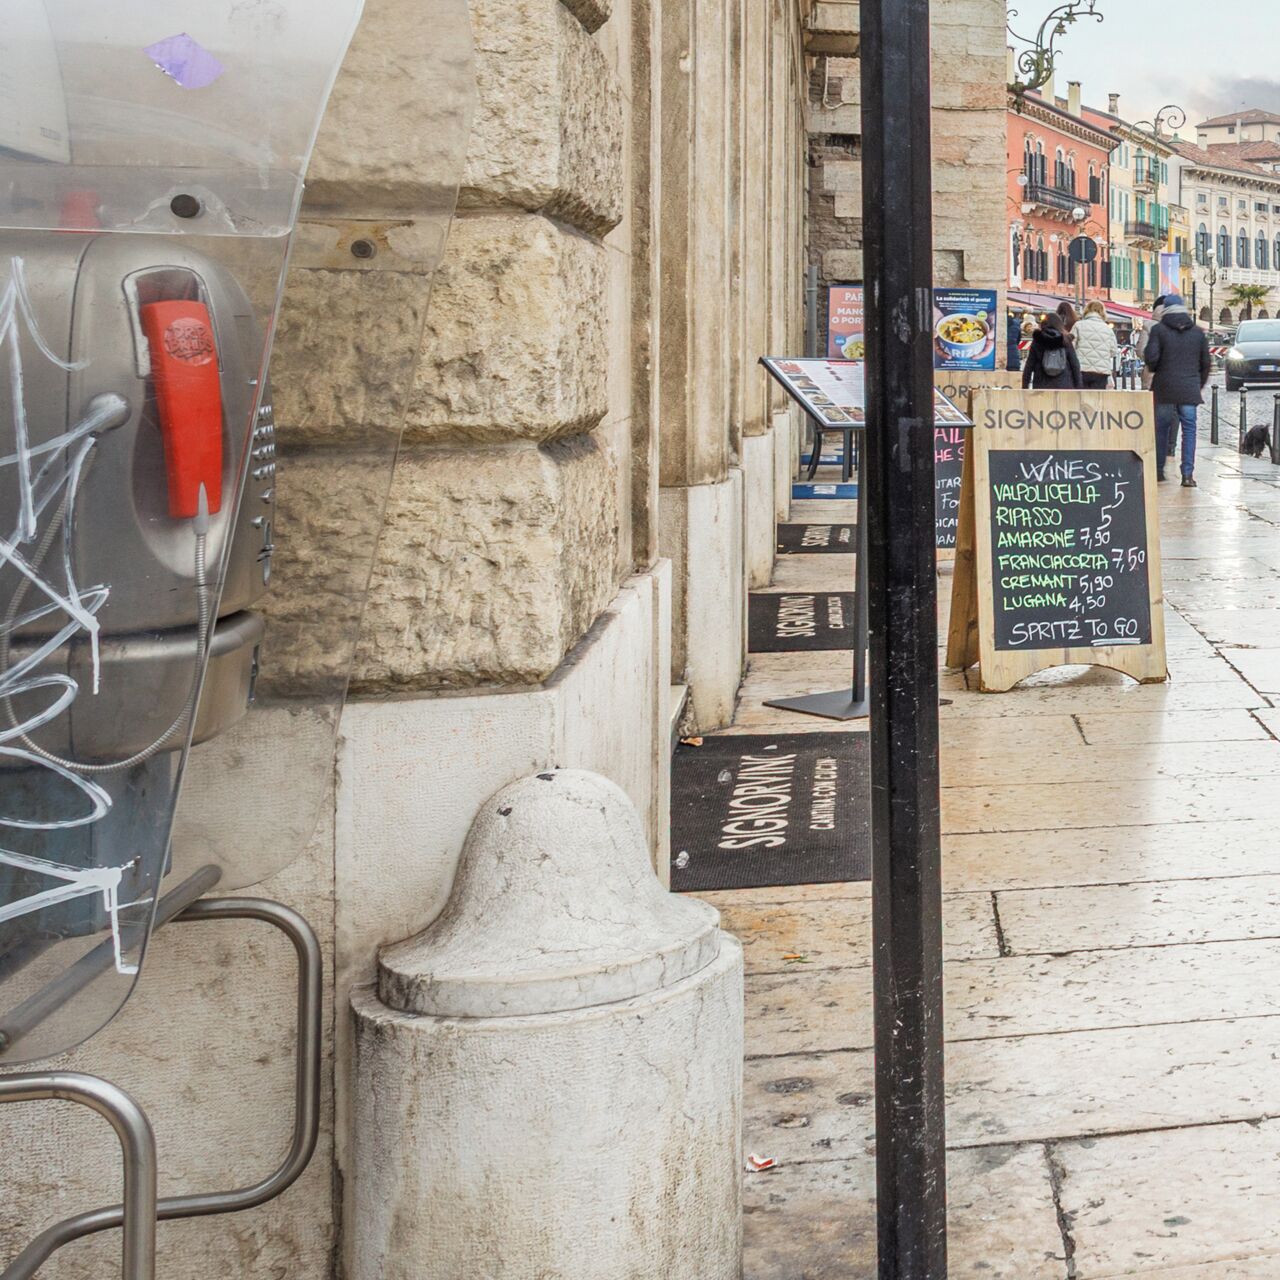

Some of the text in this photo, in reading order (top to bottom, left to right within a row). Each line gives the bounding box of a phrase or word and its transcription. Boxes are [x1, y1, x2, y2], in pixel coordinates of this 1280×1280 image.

[845, 291, 864, 301] PAR
[984, 408, 1144, 430] SIGNORVINO
[993, 481, 1130, 509] VALPOLICELLA 5
[996, 505, 1113, 529] RIPASSO 5
[997, 527, 1111, 550] AMARONE 7,90
[998, 546, 1146, 573] FRANCIACORTA 7,50
[1000, 574, 1114, 595] CREMANT 5,90
[1003, 592, 1106, 614] LUGANA 4,50
[1008, 620, 1083, 646] SPRITZ
[1114, 617, 1138, 637] GO
[813, 756, 839, 780] CUCIN
